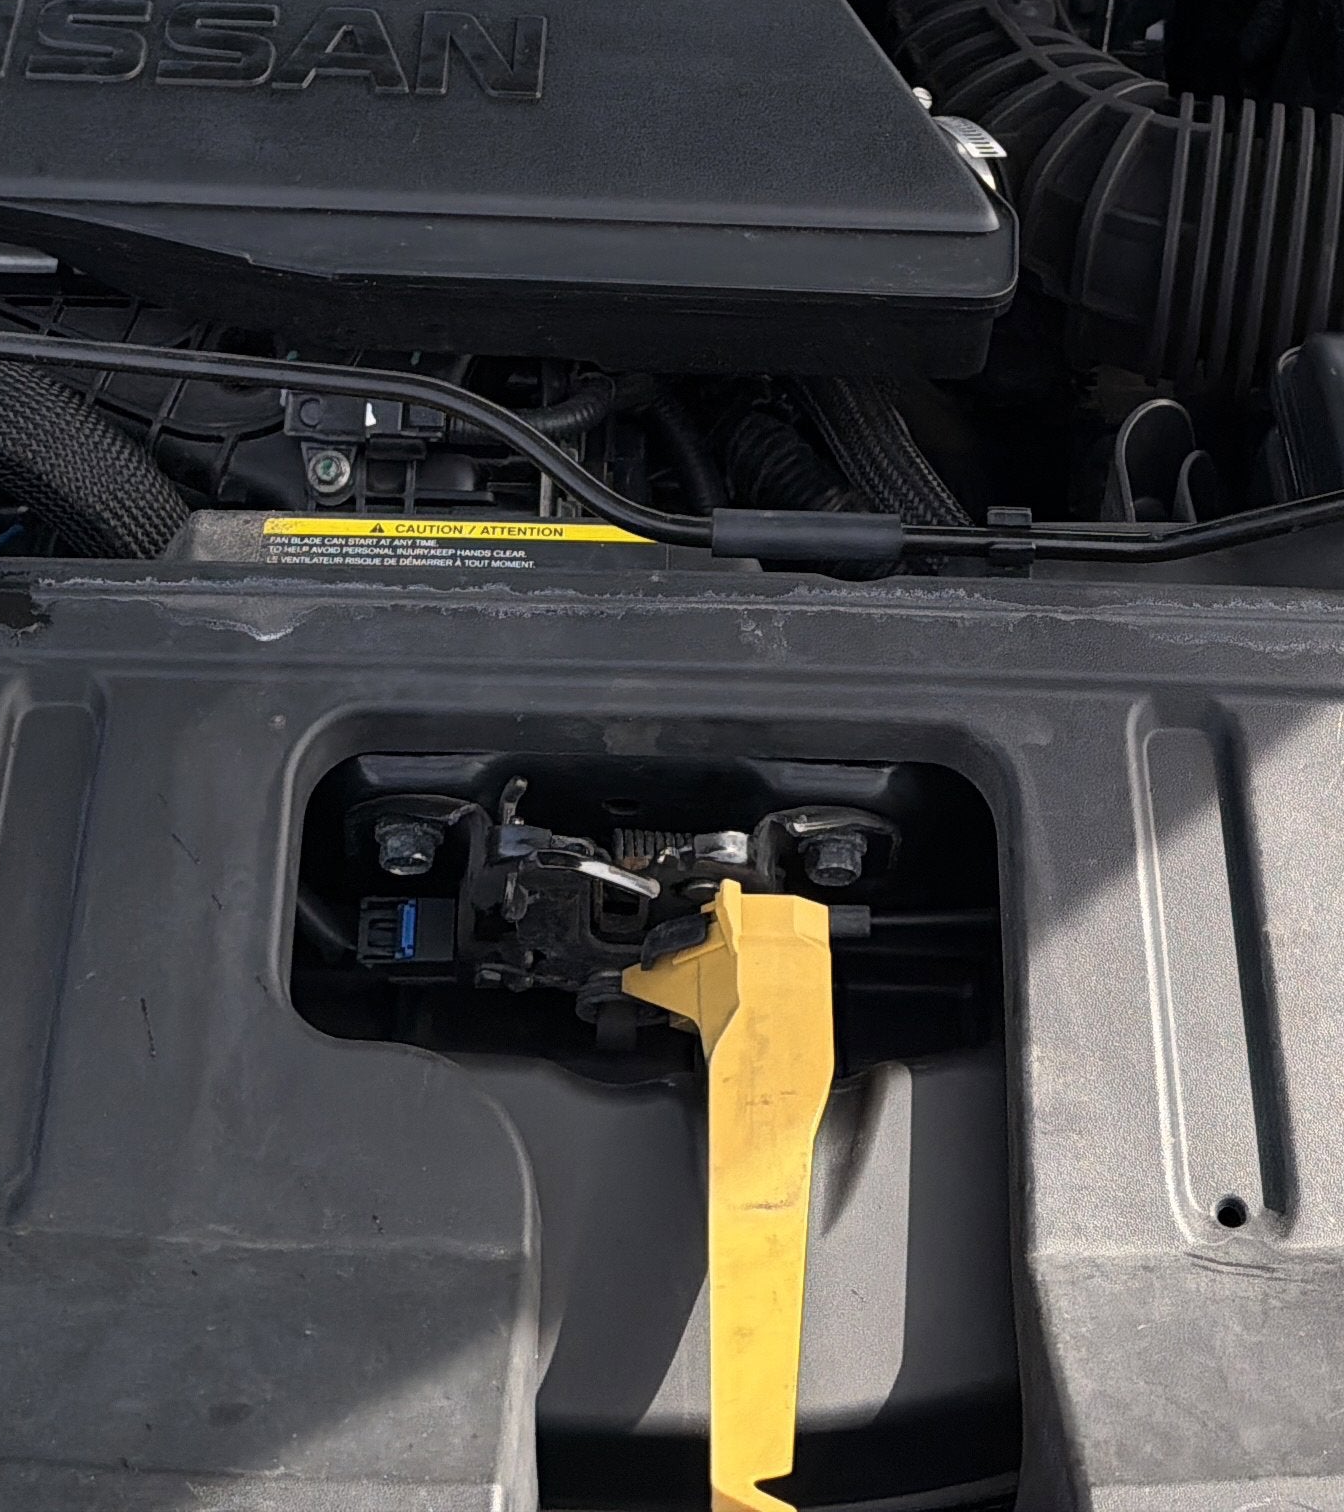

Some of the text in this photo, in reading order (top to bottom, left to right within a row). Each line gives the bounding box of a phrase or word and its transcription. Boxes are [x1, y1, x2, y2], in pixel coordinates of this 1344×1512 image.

[395, 523, 463, 535] CAUTION
[480, 525, 564, 537] ATTENTION
[324, 537, 346, 545] CAN
[347, 537, 378, 546] START
[378, 538, 393, 546] AT
[415, 539, 439, 547] TIME.
[268, 545, 283, 554] TO
[284, 544, 309, 554] HELP
[310, 546, 341, 554] AVOID
[342, 546, 394, 555] PERSONAL
[456, 548, 491, 557] HANDS
[493, 549, 527, 558] CLEAR.
[266, 555, 278, 564] LE
[280, 555, 344, 565] VENTILATEUR
[345, 556, 382, 566] RISQUE
[383, 558, 397, 566] DE
[399, 556, 453, 566] DÉMARRER
[454, 556, 462, 567] À
[490, 559, 536, 569] MOMENT.
